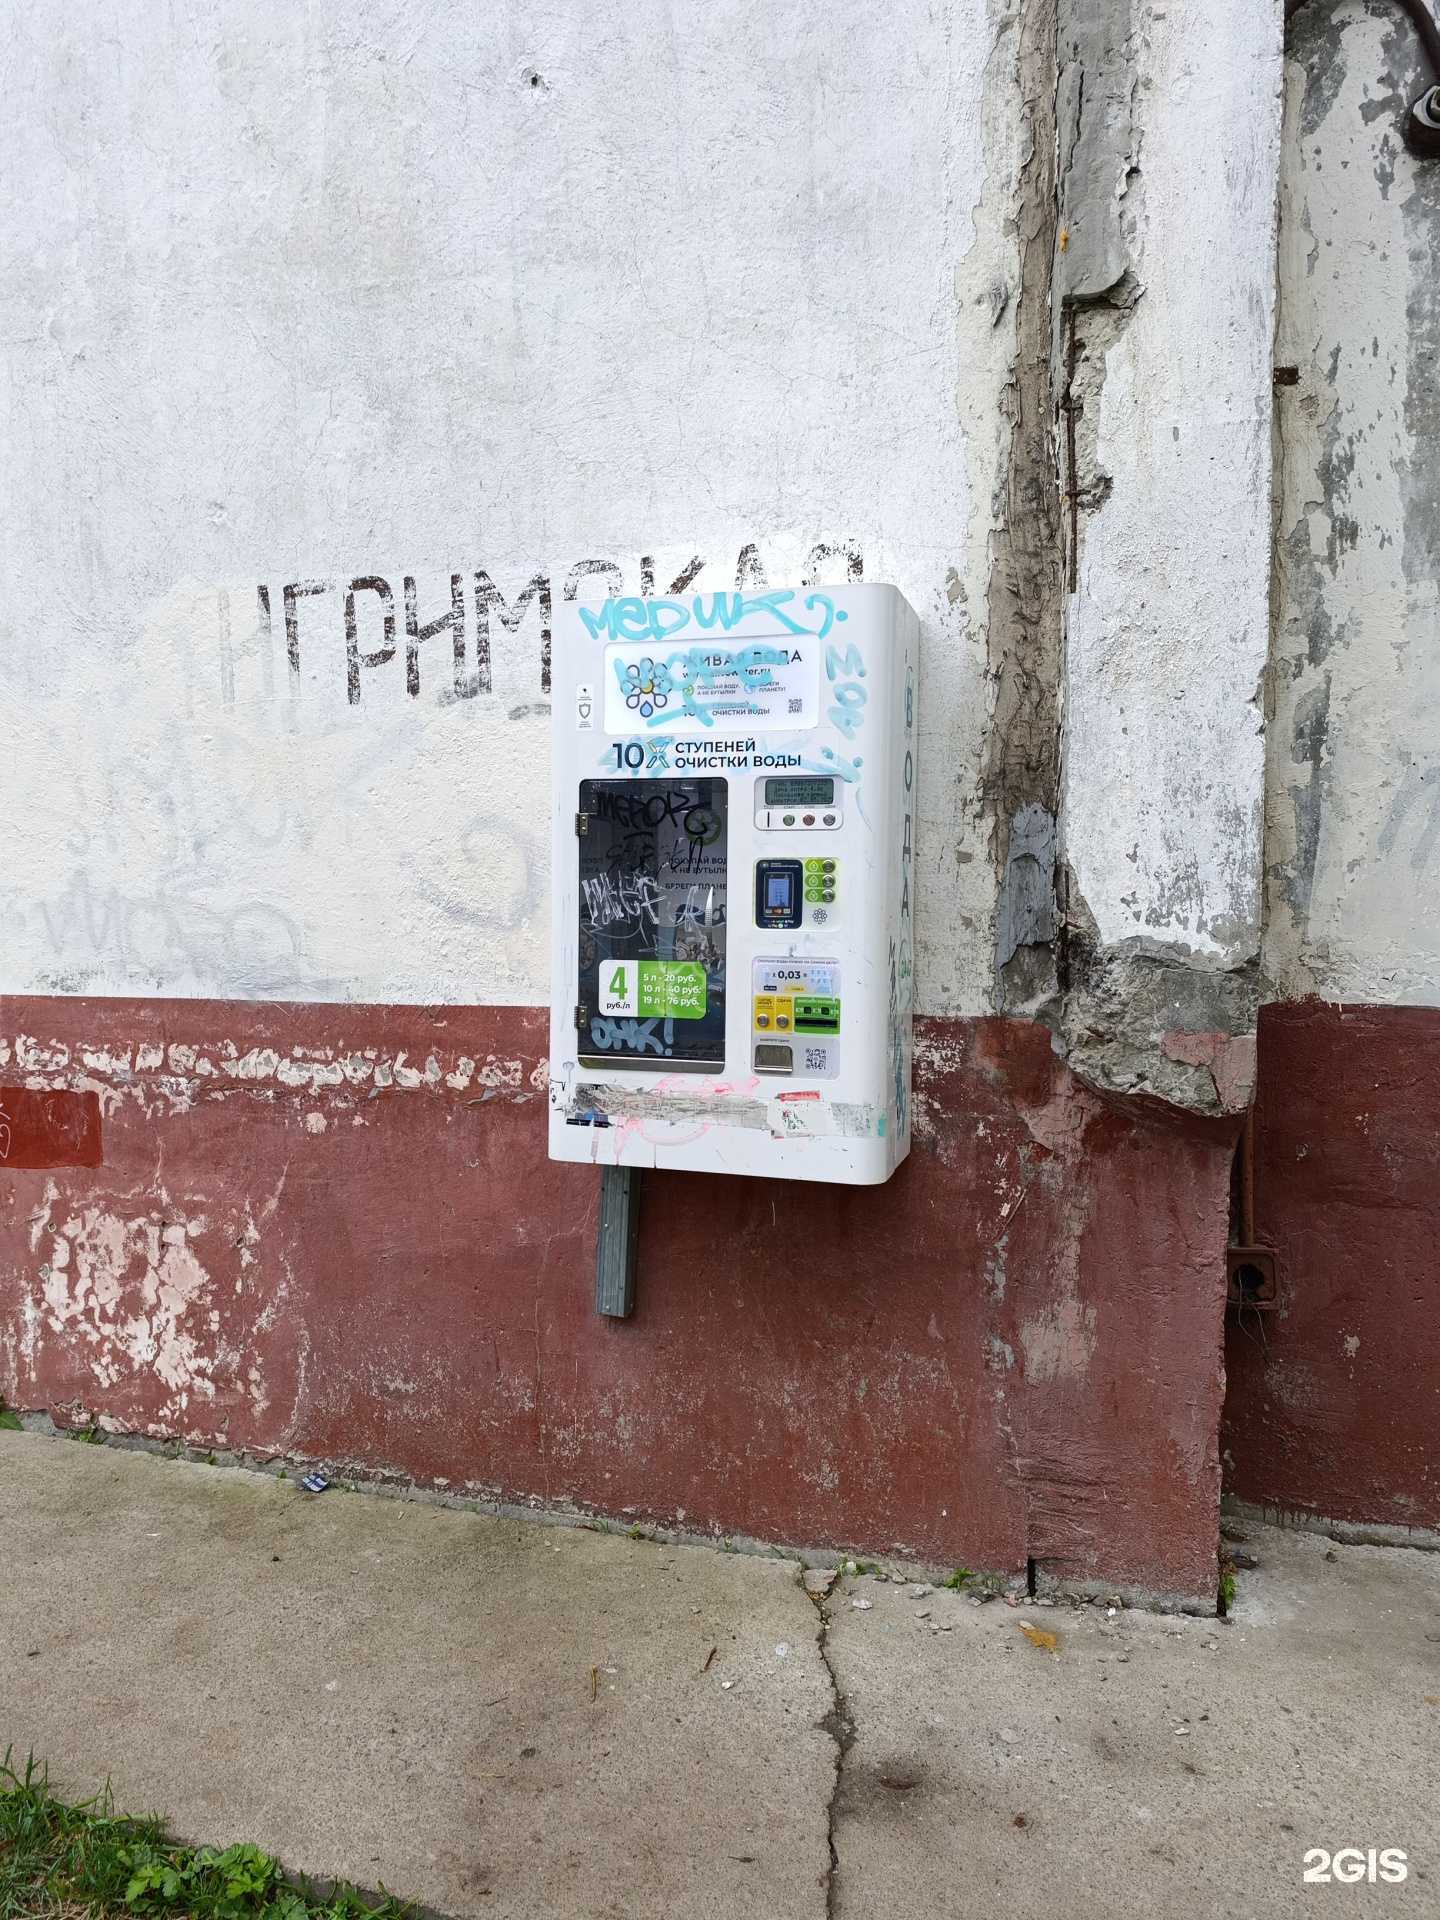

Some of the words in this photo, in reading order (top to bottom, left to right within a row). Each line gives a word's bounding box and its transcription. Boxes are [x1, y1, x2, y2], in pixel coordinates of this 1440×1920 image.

[675, 737, 756, 754] СТУПЕНЕЙ
[675, 756, 748, 769] ОЧИСТКИ
[752, 754, 801, 769] ВОДЫ
[643, 973, 649, 981] 5
[664, 974, 676, 982] 20
[677, 974, 697, 984] руб.
[777, 970, 801, 981] 0,03
[609, 966, 629, 1001] 4
[643, 984, 653, 993] 10
[606, 1001, 631, 1010] руб./л
[680, 996, 700, 1007] руб.
